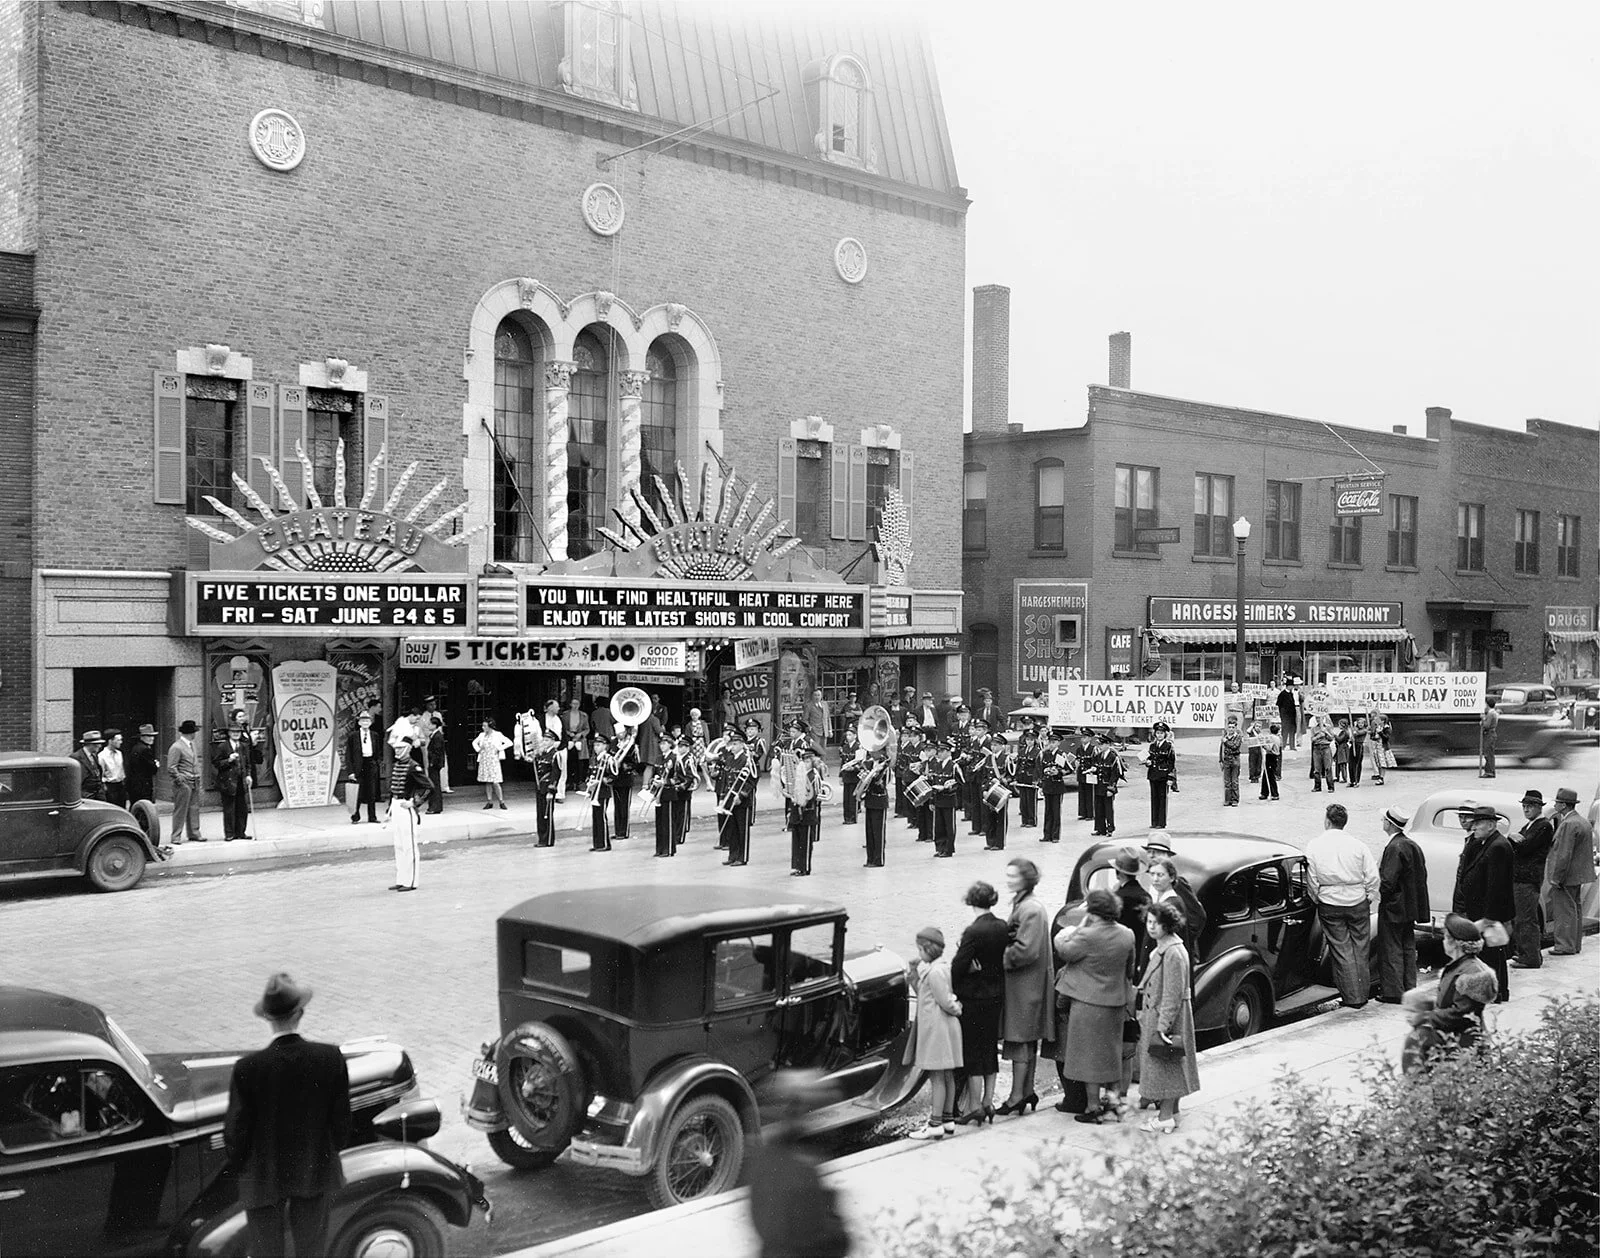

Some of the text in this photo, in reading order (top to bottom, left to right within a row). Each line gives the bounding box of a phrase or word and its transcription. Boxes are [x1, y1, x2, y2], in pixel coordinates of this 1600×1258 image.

[259, 511, 424, 555] CHATEAU
[653, 525, 762, 565] CHATEAU
[203, 584, 461, 602] FIVE TICKETS ONE DOLLAR
[538, 588, 853, 609] YOU WILL FIND HEALTHFUL HEAT RELIEF HERE
[222, 607, 254, 623] FRI
[281, 607, 319, 623] SAT
[332, 608, 381, 624] JUNE
[393, 608, 417, 624] 24
[424, 608, 436, 623] &
[442, 608, 455, 624] 5
[543, 610, 850, 627] ENJOY THE LATEST SHOWS IN COOL COMFORT
[1309, 605, 1389, 622] RESTAURANT
[1549, 614, 1587, 627] DRUGS
[1111, 634, 1131, 648] CAFE
[445, 641, 461, 660] 5
[467, 640, 566, 661] TICKETS
[582, 643, 635, 662] $1.00
[647, 646, 678, 656] GOOD
[532, 660, 573, 668] SATURDAY
[1022, 664, 1082, 682] LUNCHES
[1403, 676, 1446, 685] TICKETS
[1058, 684, 1069, 696] 5
[1079, 684, 1124, 696] TIME
[1134, 684, 1191, 697] TICKETS
[1422, 688, 1448, 702] DAY
[1453, 689, 1477, 697] TODAY
[1083, 700, 1147, 714] DOLLAR
[1154, 700, 1185, 714] DAY
[1190, 702, 1218, 712] TODAY
[1453, 698, 1477, 708] ONLY
[1091, 715, 1176, 724] THEATRE TICKET SALE
[1193, 712, 1215, 722] ONLY
[281, 717, 328, 732] DOLLAR
[294, 731, 315, 741] DAY
[293, 740, 315, 751] SALE
